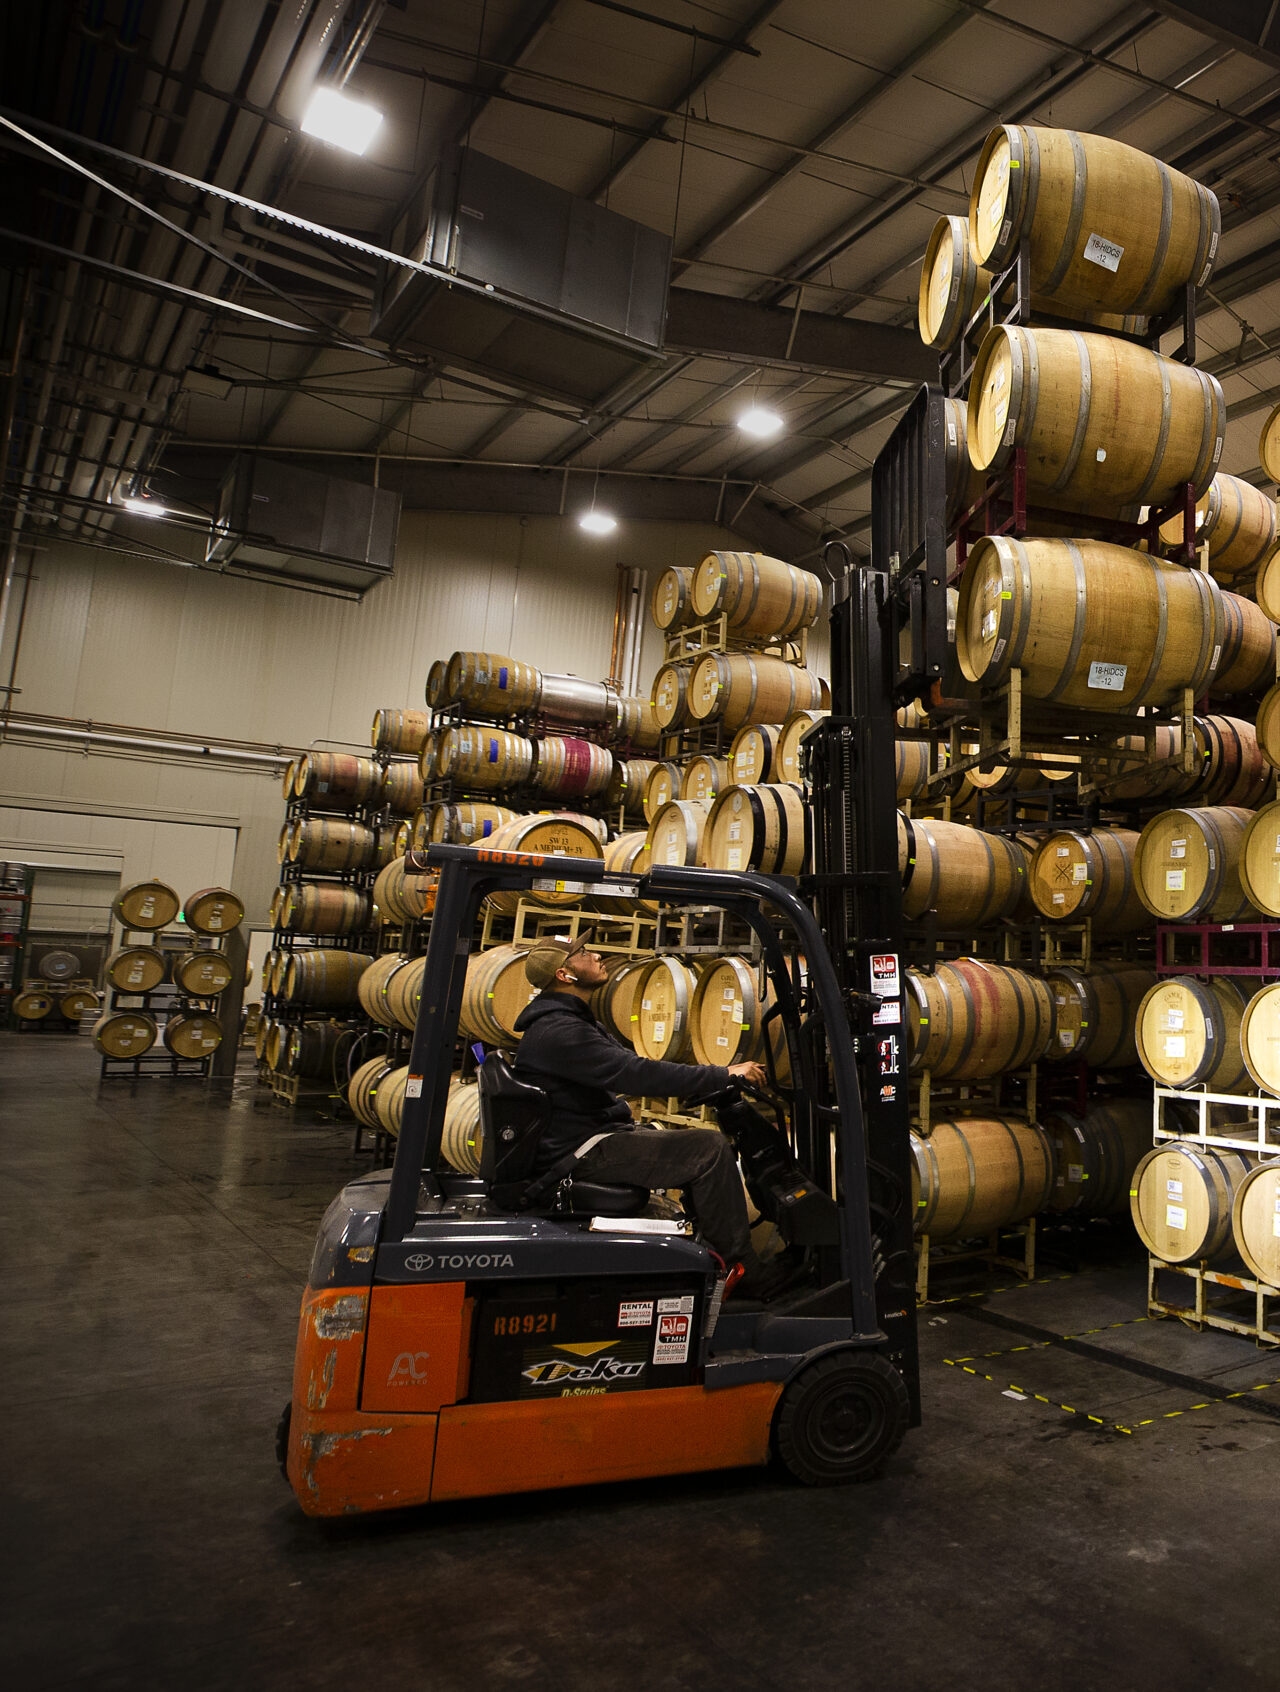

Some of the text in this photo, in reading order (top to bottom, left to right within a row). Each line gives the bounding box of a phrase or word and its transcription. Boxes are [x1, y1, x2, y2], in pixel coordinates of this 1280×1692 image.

[1096, 254, 1107, 264] -12
[1095, 666, 1125, 677] 18-HIDCS
[1101, 677, 1112, 686] -12
[437, 1254, 515, 1269] TOYOTA
[621, 1303, 652, 1311] RENTAL
[493, 1313, 557, 1336] R8921
[665, 1335, 686, 1343] TMH
[388, 1352, 430, 1380] AC
[526, 1358, 647, 1384] Deka
[386, 1379, 428, 1388] POWERED
[562, 1386, 607, 1398] D-Series
